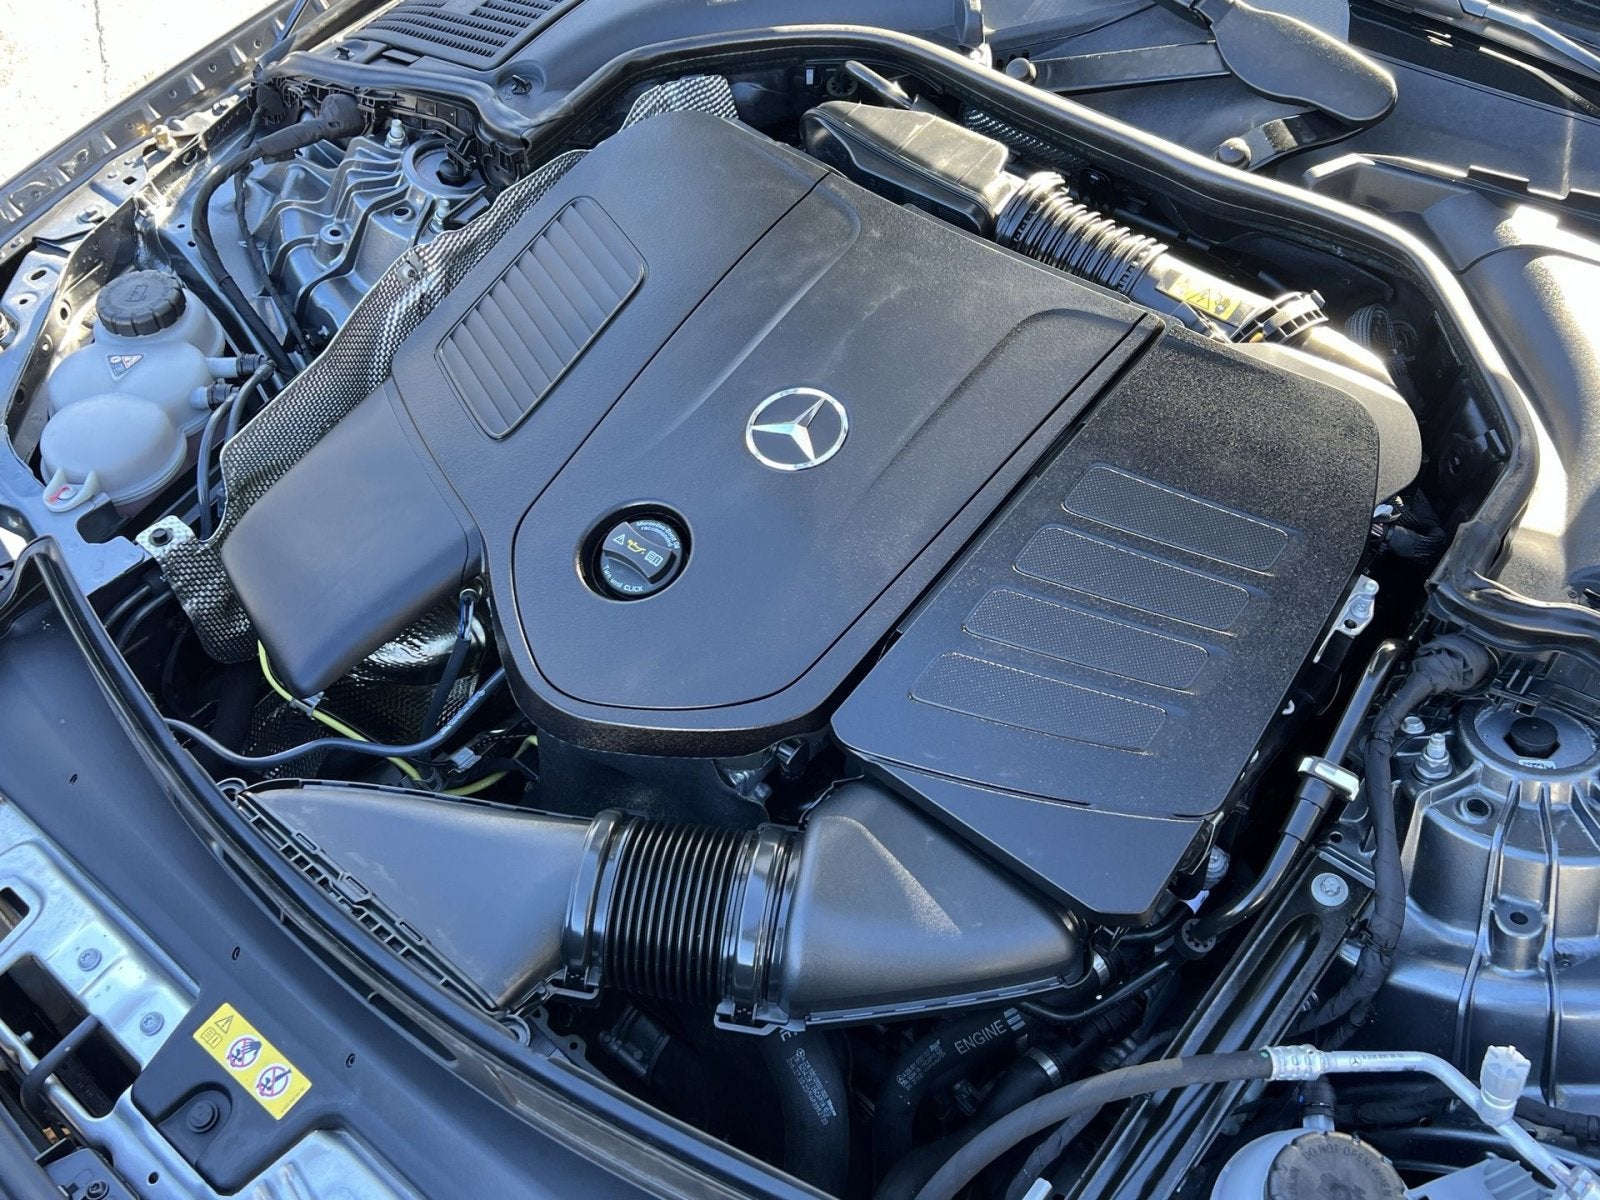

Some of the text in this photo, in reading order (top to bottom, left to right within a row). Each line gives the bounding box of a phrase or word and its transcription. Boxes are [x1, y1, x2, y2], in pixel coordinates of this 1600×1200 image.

[603, 565, 612, 579] Turn
[954, 1019, 1007, 1055] ENGINE
[1302, 1148, 1318, 1161] DO
[1318, 1144, 1340, 1154] NOT
[1343, 1147, 1371, 1167] OPEN
